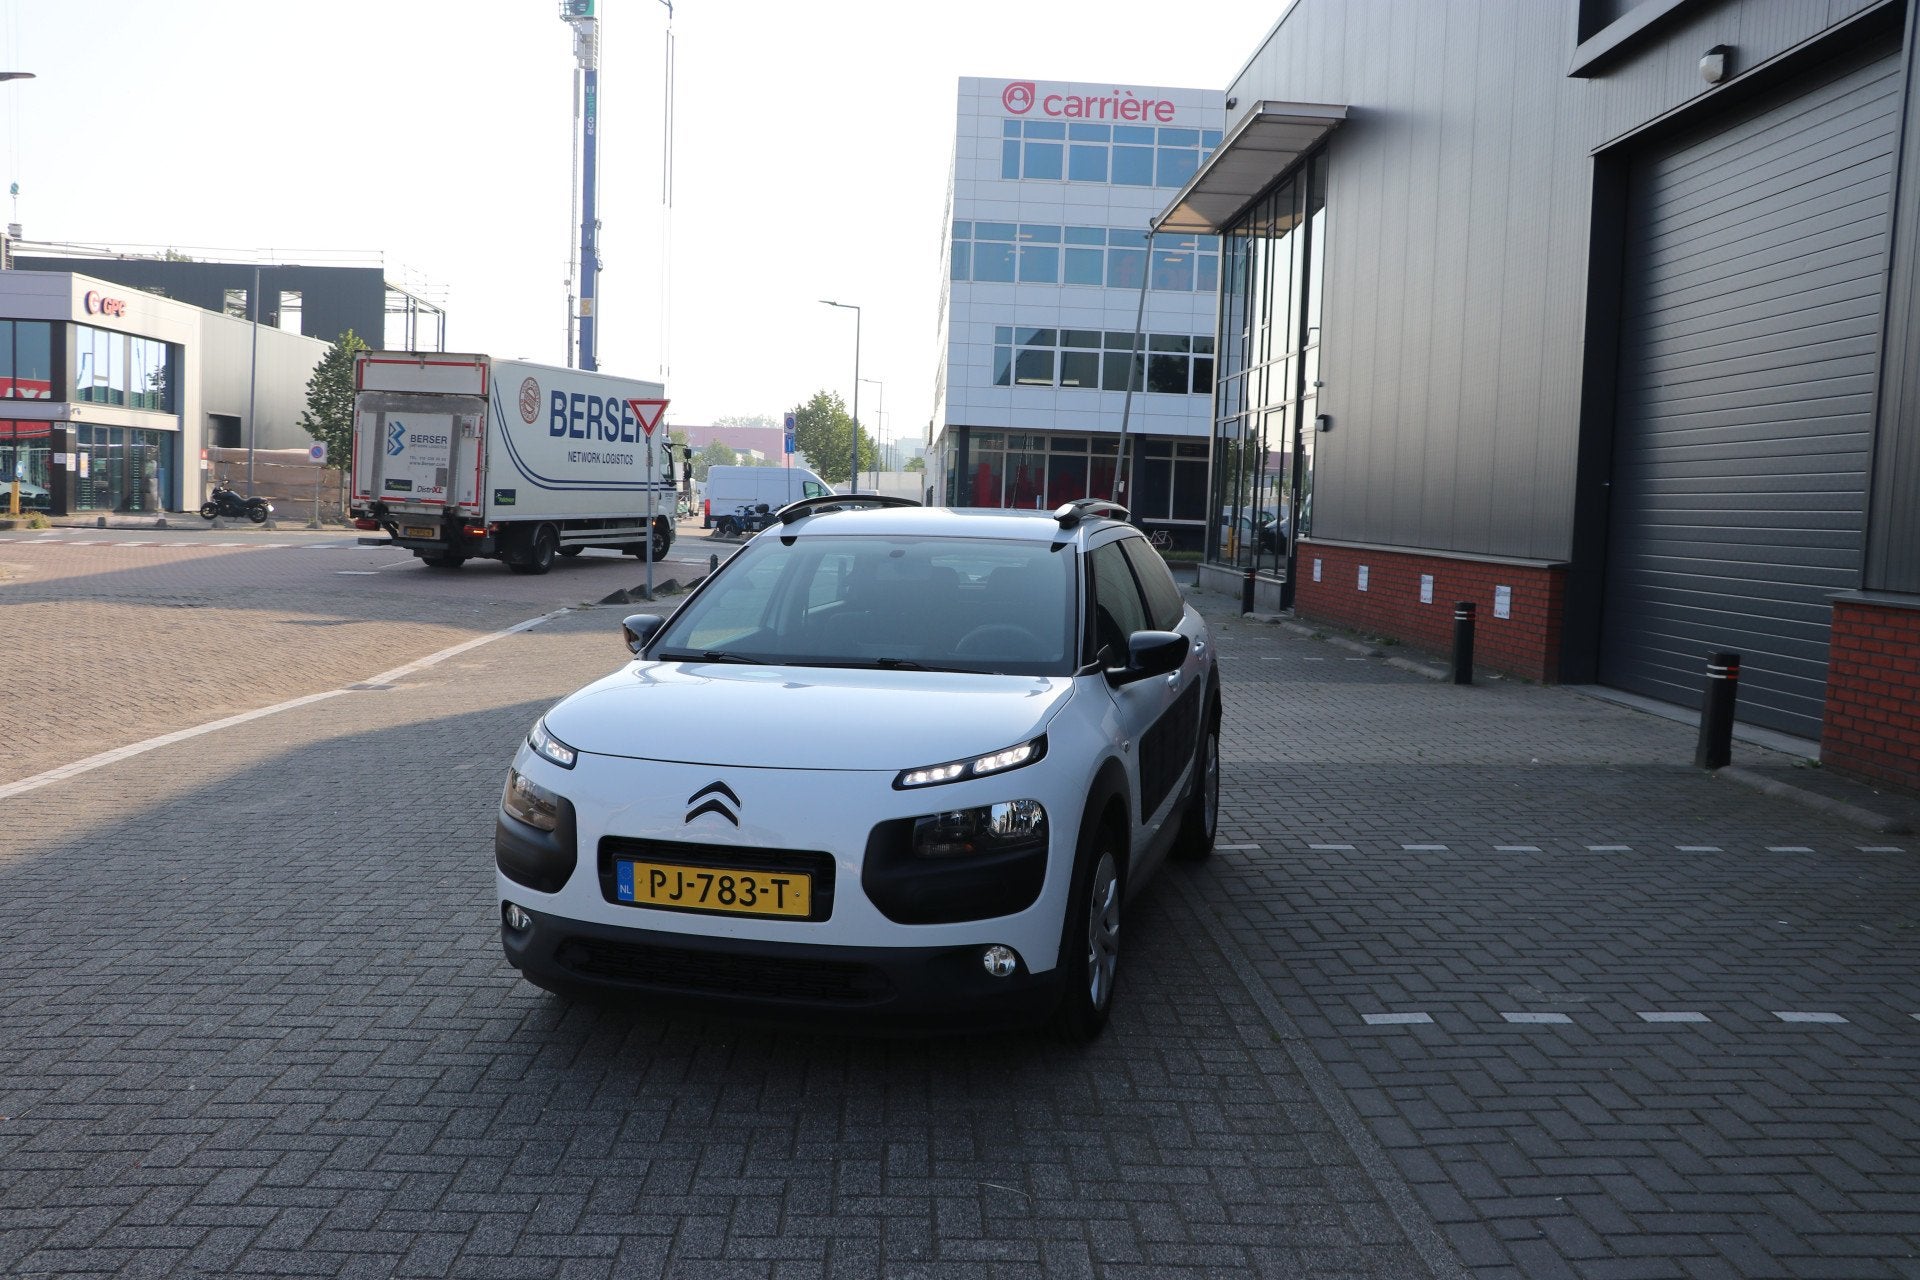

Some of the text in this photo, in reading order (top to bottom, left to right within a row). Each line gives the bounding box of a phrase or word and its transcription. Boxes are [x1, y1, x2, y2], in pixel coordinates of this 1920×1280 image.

[1043, 90, 1175, 122] carrière
[102, 297, 126, 317] GPC
[410, 434, 448, 445] BERSER
[568, 451, 634, 465] NETWORK LOGISTICS
[620, 884, 632, 895] NL
[650, 869, 790, 909] PJ-783-T
